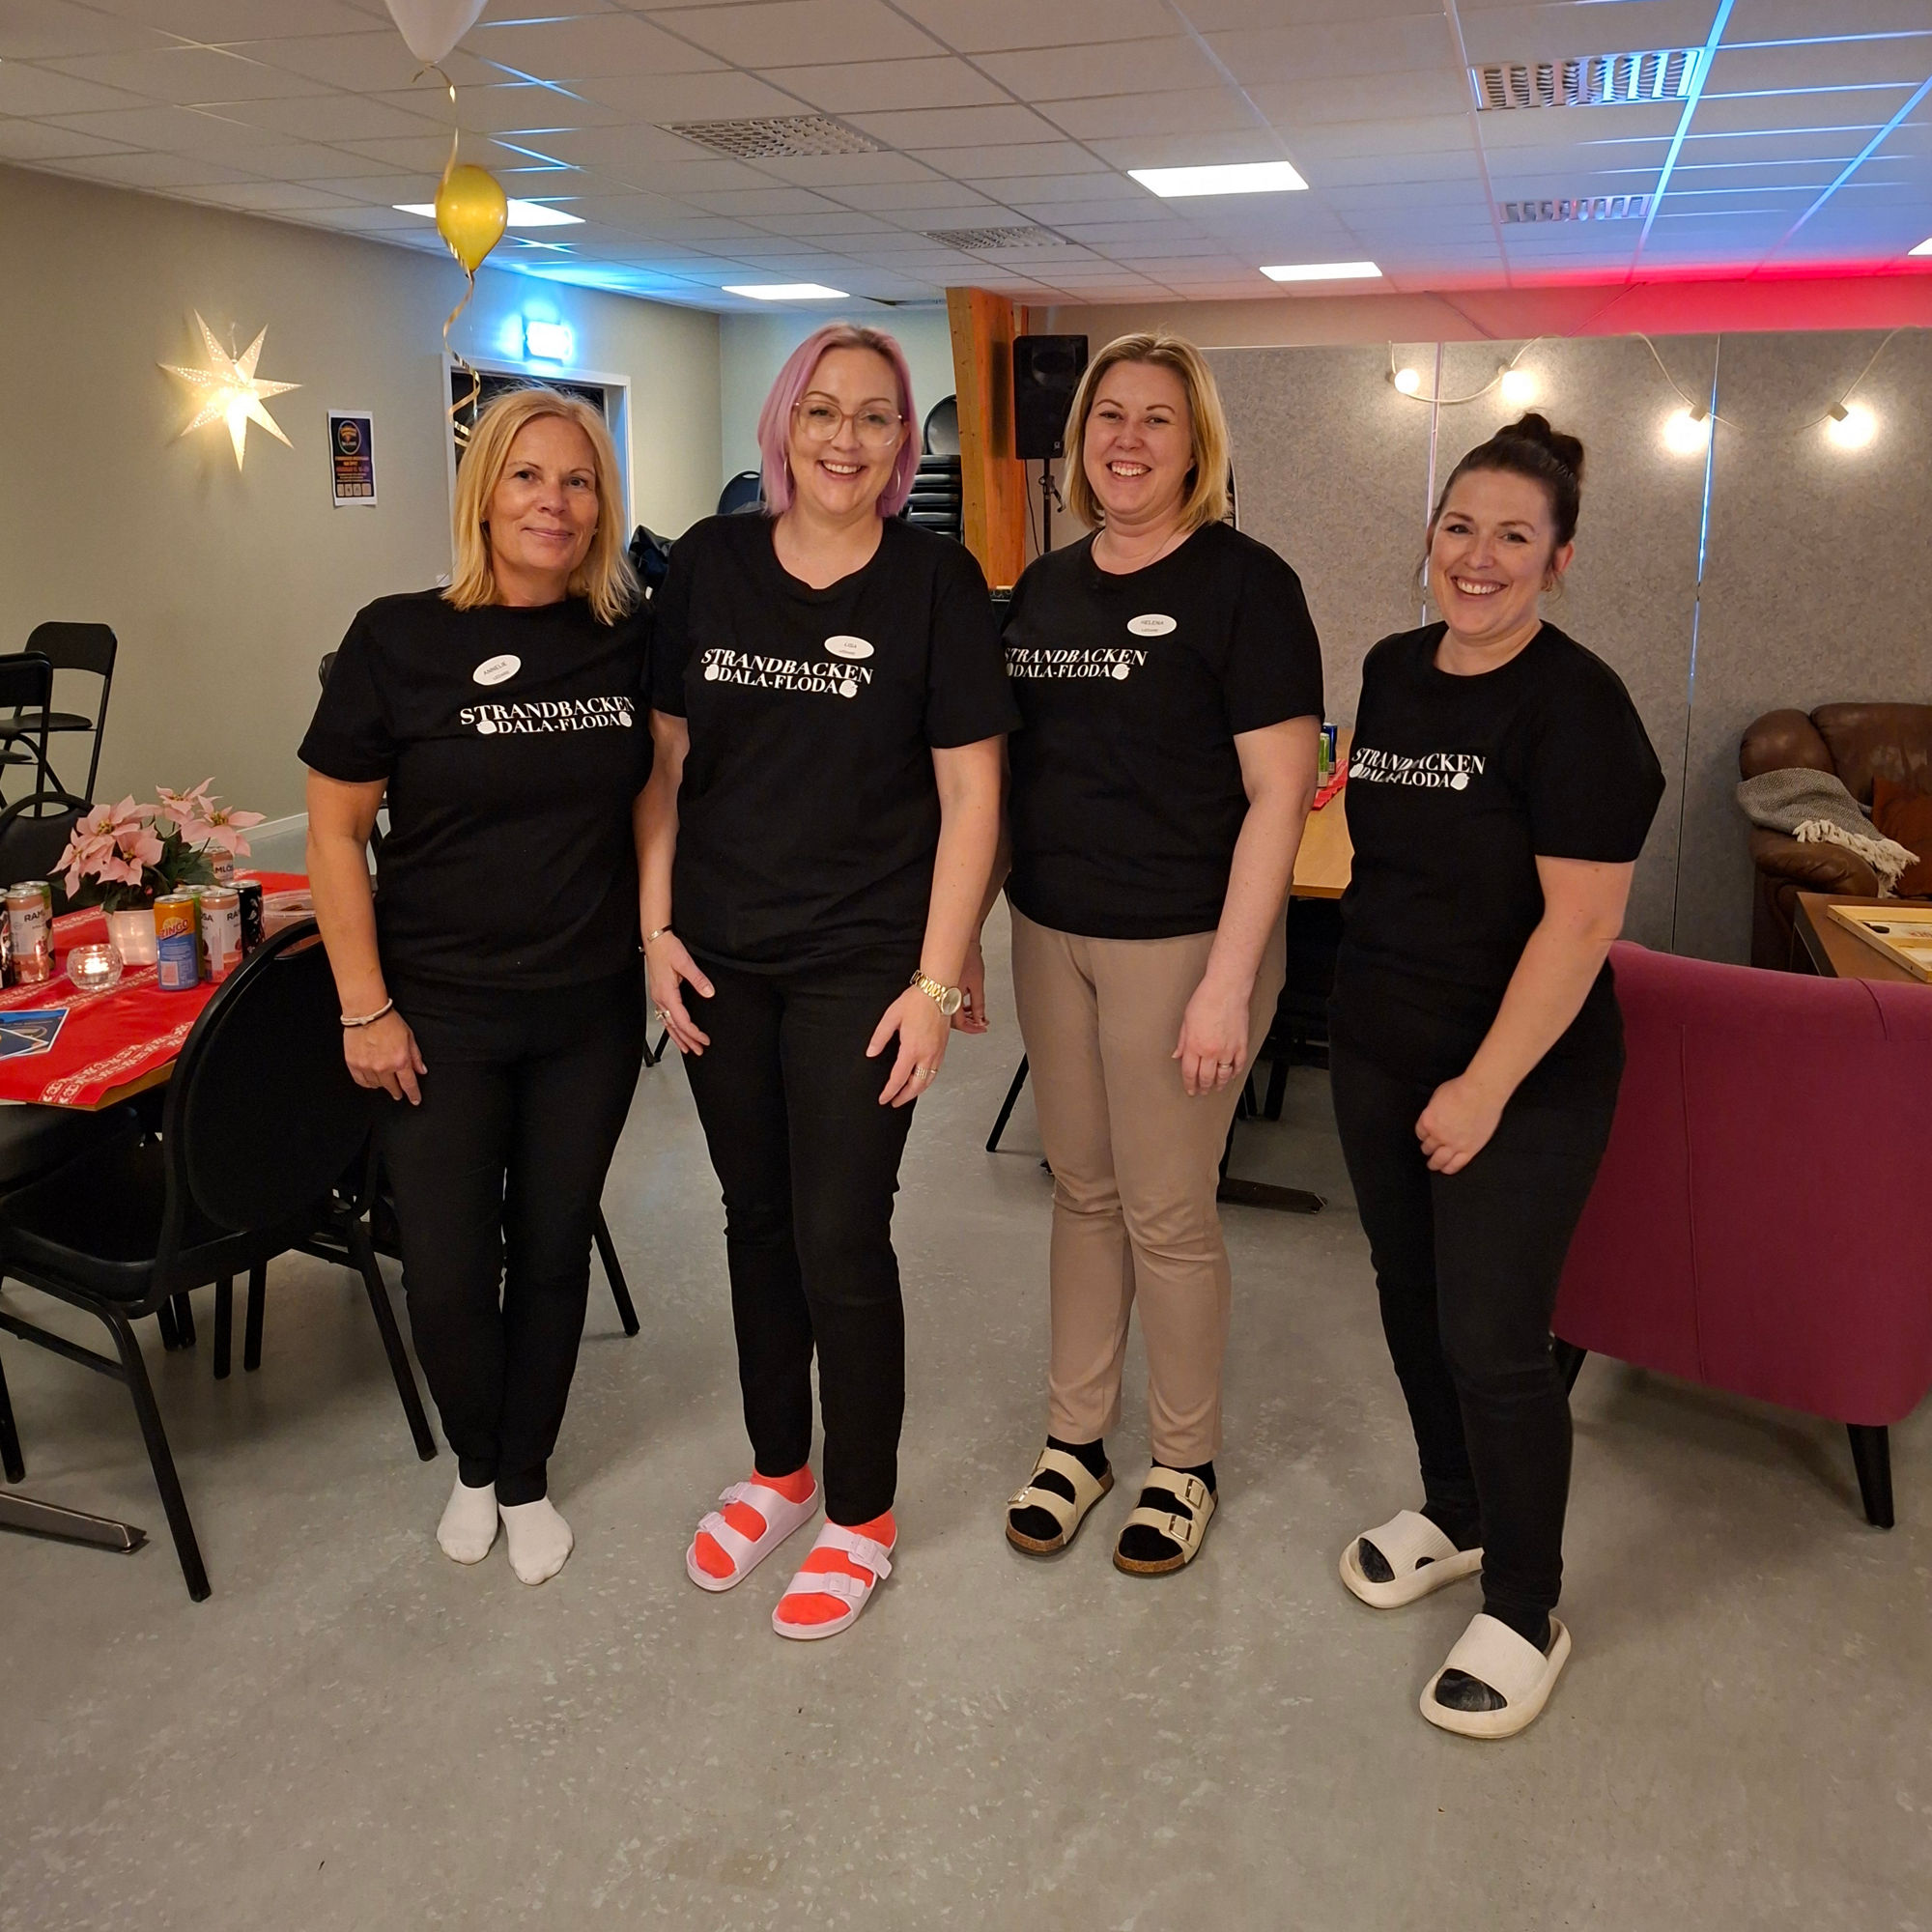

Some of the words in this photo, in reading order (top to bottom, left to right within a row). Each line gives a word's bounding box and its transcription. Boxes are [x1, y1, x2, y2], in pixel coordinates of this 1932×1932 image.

[701, 648, 873, 685] STRANDBACKEN
[1013, 664, 1111, 678] DALA-FLODA
[718, 668, 838, 695] DALA-FLODA
[460, 696, 636, 725] STRANDBACKEN
[497, 713, 621, 734] DALA-FLODA
[159, 919, 188, 939] ZINGO
